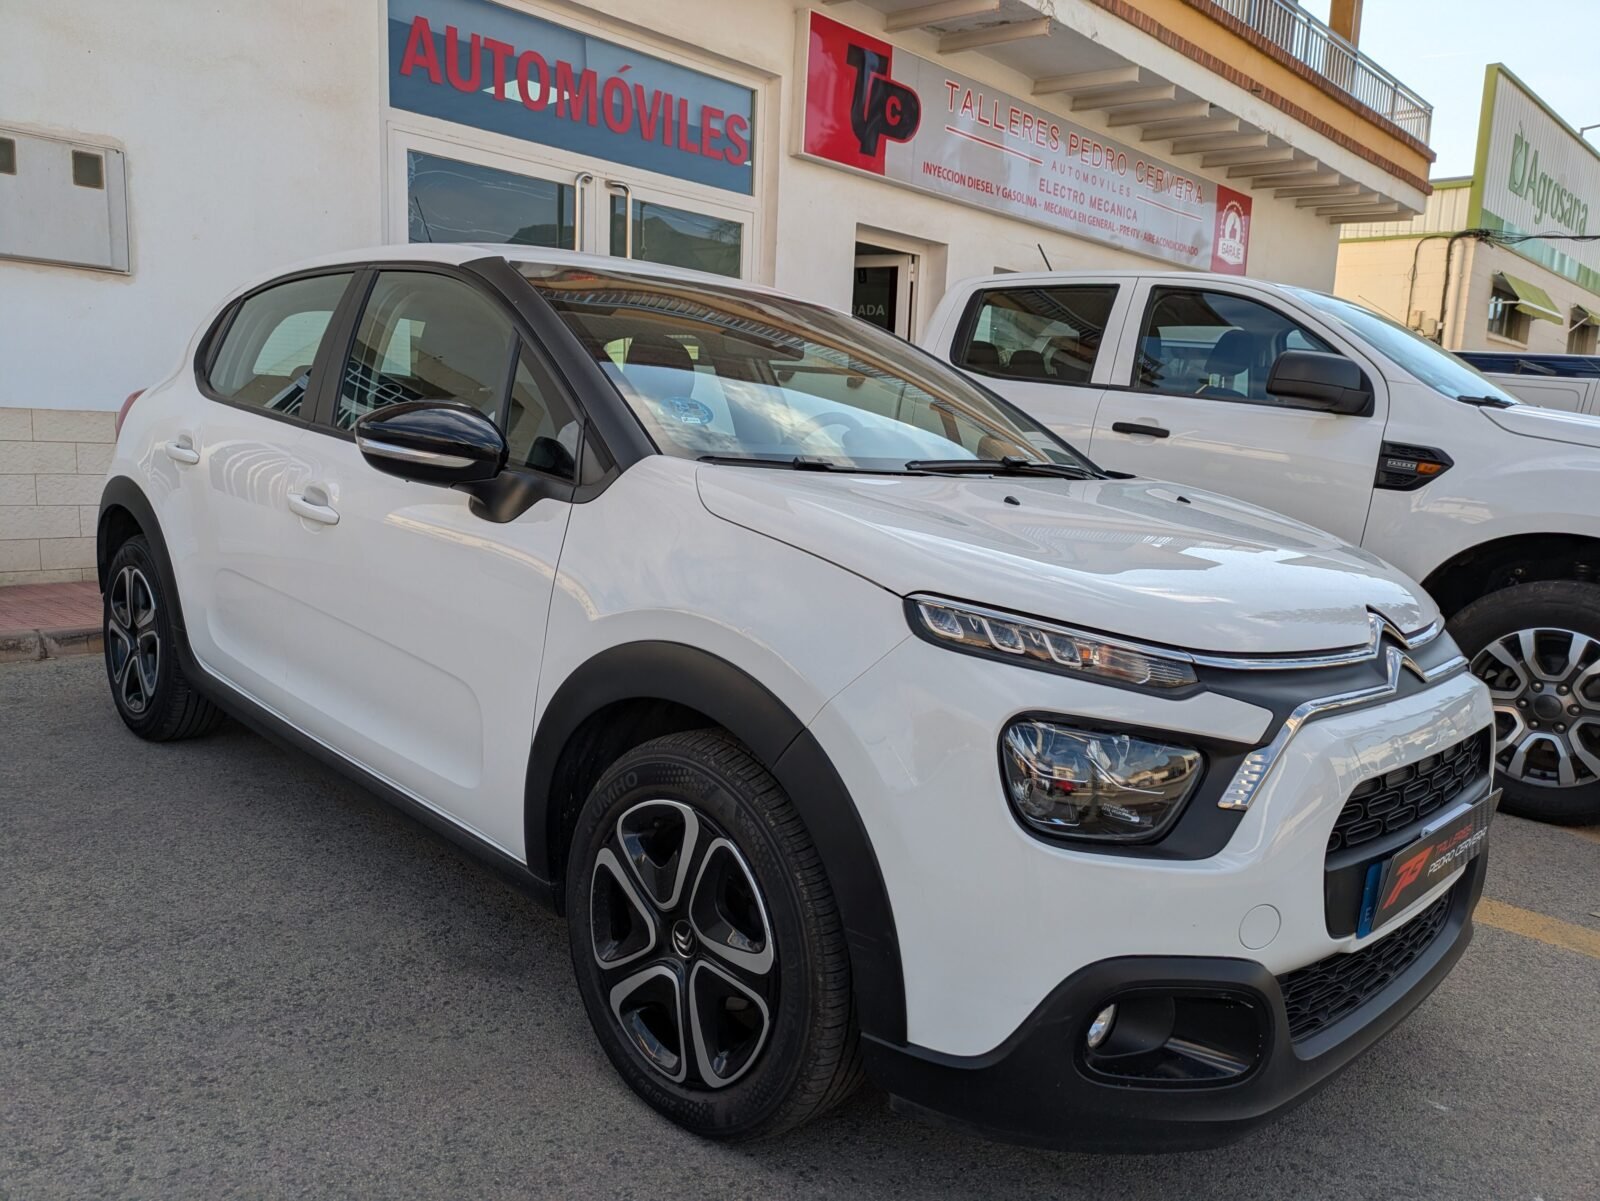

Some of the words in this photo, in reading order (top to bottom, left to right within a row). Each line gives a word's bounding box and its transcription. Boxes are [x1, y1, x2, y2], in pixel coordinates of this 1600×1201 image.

[400, 15, 748, 165] AUTOMÓVILES
[945, 79, 1060, 152] TALLERES
[1067, 131, 1128, 177] PEDRO
[1135, 159, 1204, 204] CERVERA
[1051, 160, 1131, 197] AUTOMOVILES
[923, 161, 966, 186] INYECCION
[967, 177, 994, 195] DIESEL
[995, 185, 1002, 196] Y
[1002, 187, 1038, 208] GASOLINA
[1043, 201, 1077, 220] MECANICA
[1078, 212, 1086, 223] EN
[1087, 214, 1115, 232] GENERAL
[1039, 178, 1085, 205] ELECTRO
[1089, 195, 1138, 222] MECANICA
[1524, 149, 1589, 235] Agrosana
